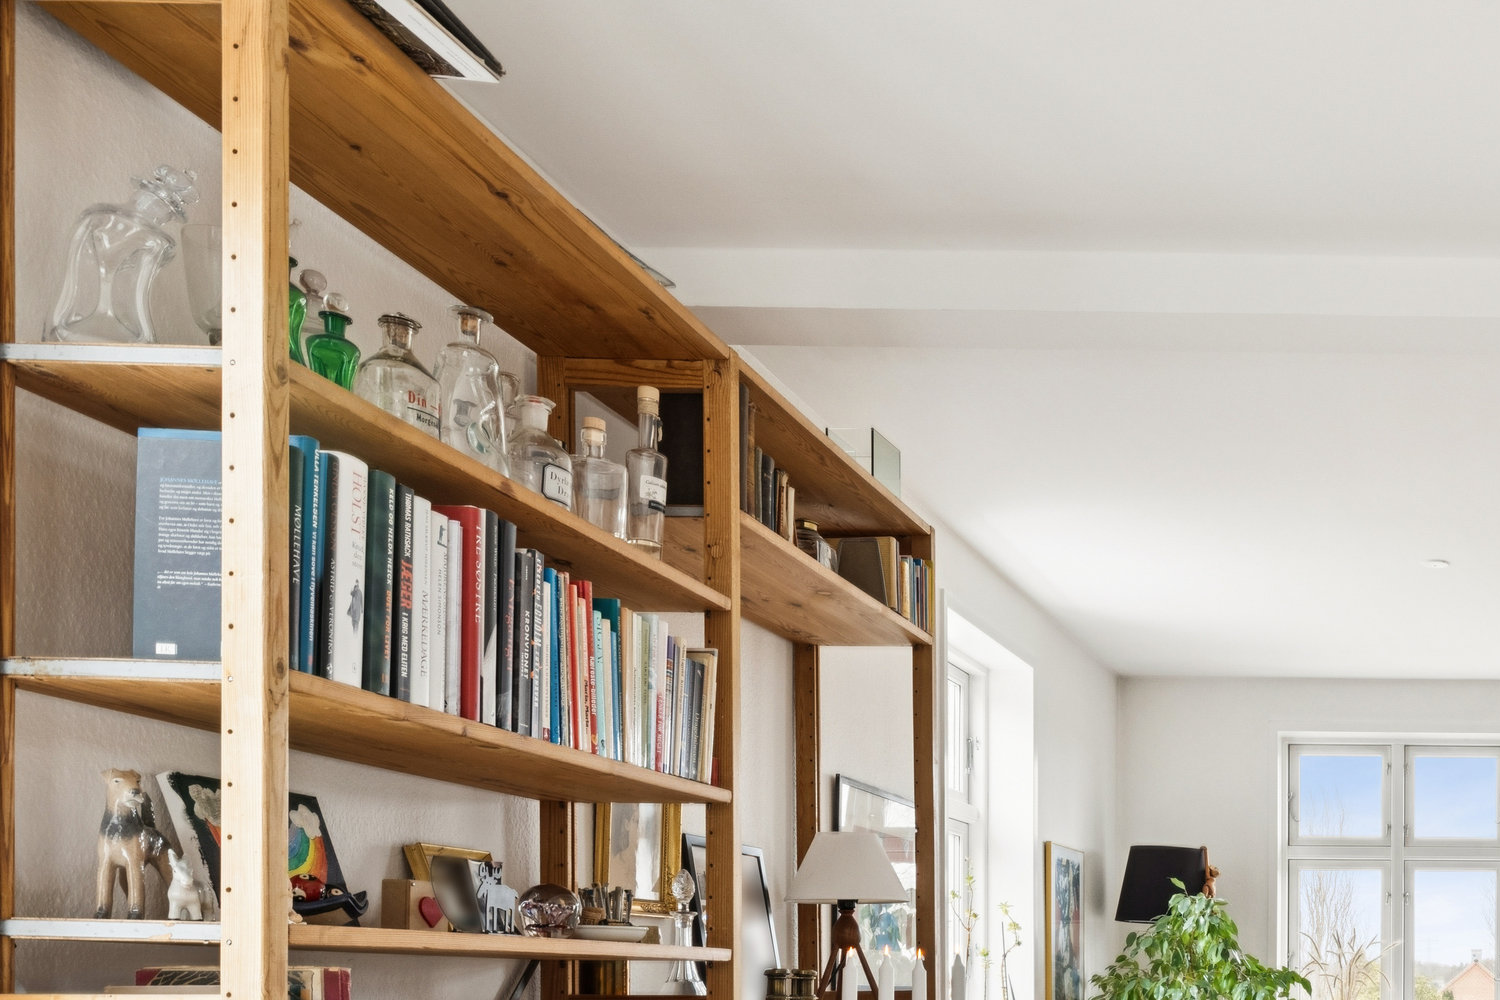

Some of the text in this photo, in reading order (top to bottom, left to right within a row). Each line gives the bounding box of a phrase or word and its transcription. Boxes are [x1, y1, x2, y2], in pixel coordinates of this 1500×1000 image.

[351, 472, 363, 534] HOLST
[404, 493, 412, 522] THOMAS
[292, 505, 302, 584] MØLLEHAVE
[403, 522, 412, 558] RATHSACK
[400, 560, 413, 609] JÆGER
[400, 653, 408, 678] ELITEN
[523, 610, 531, 679] KRONVIDNET
